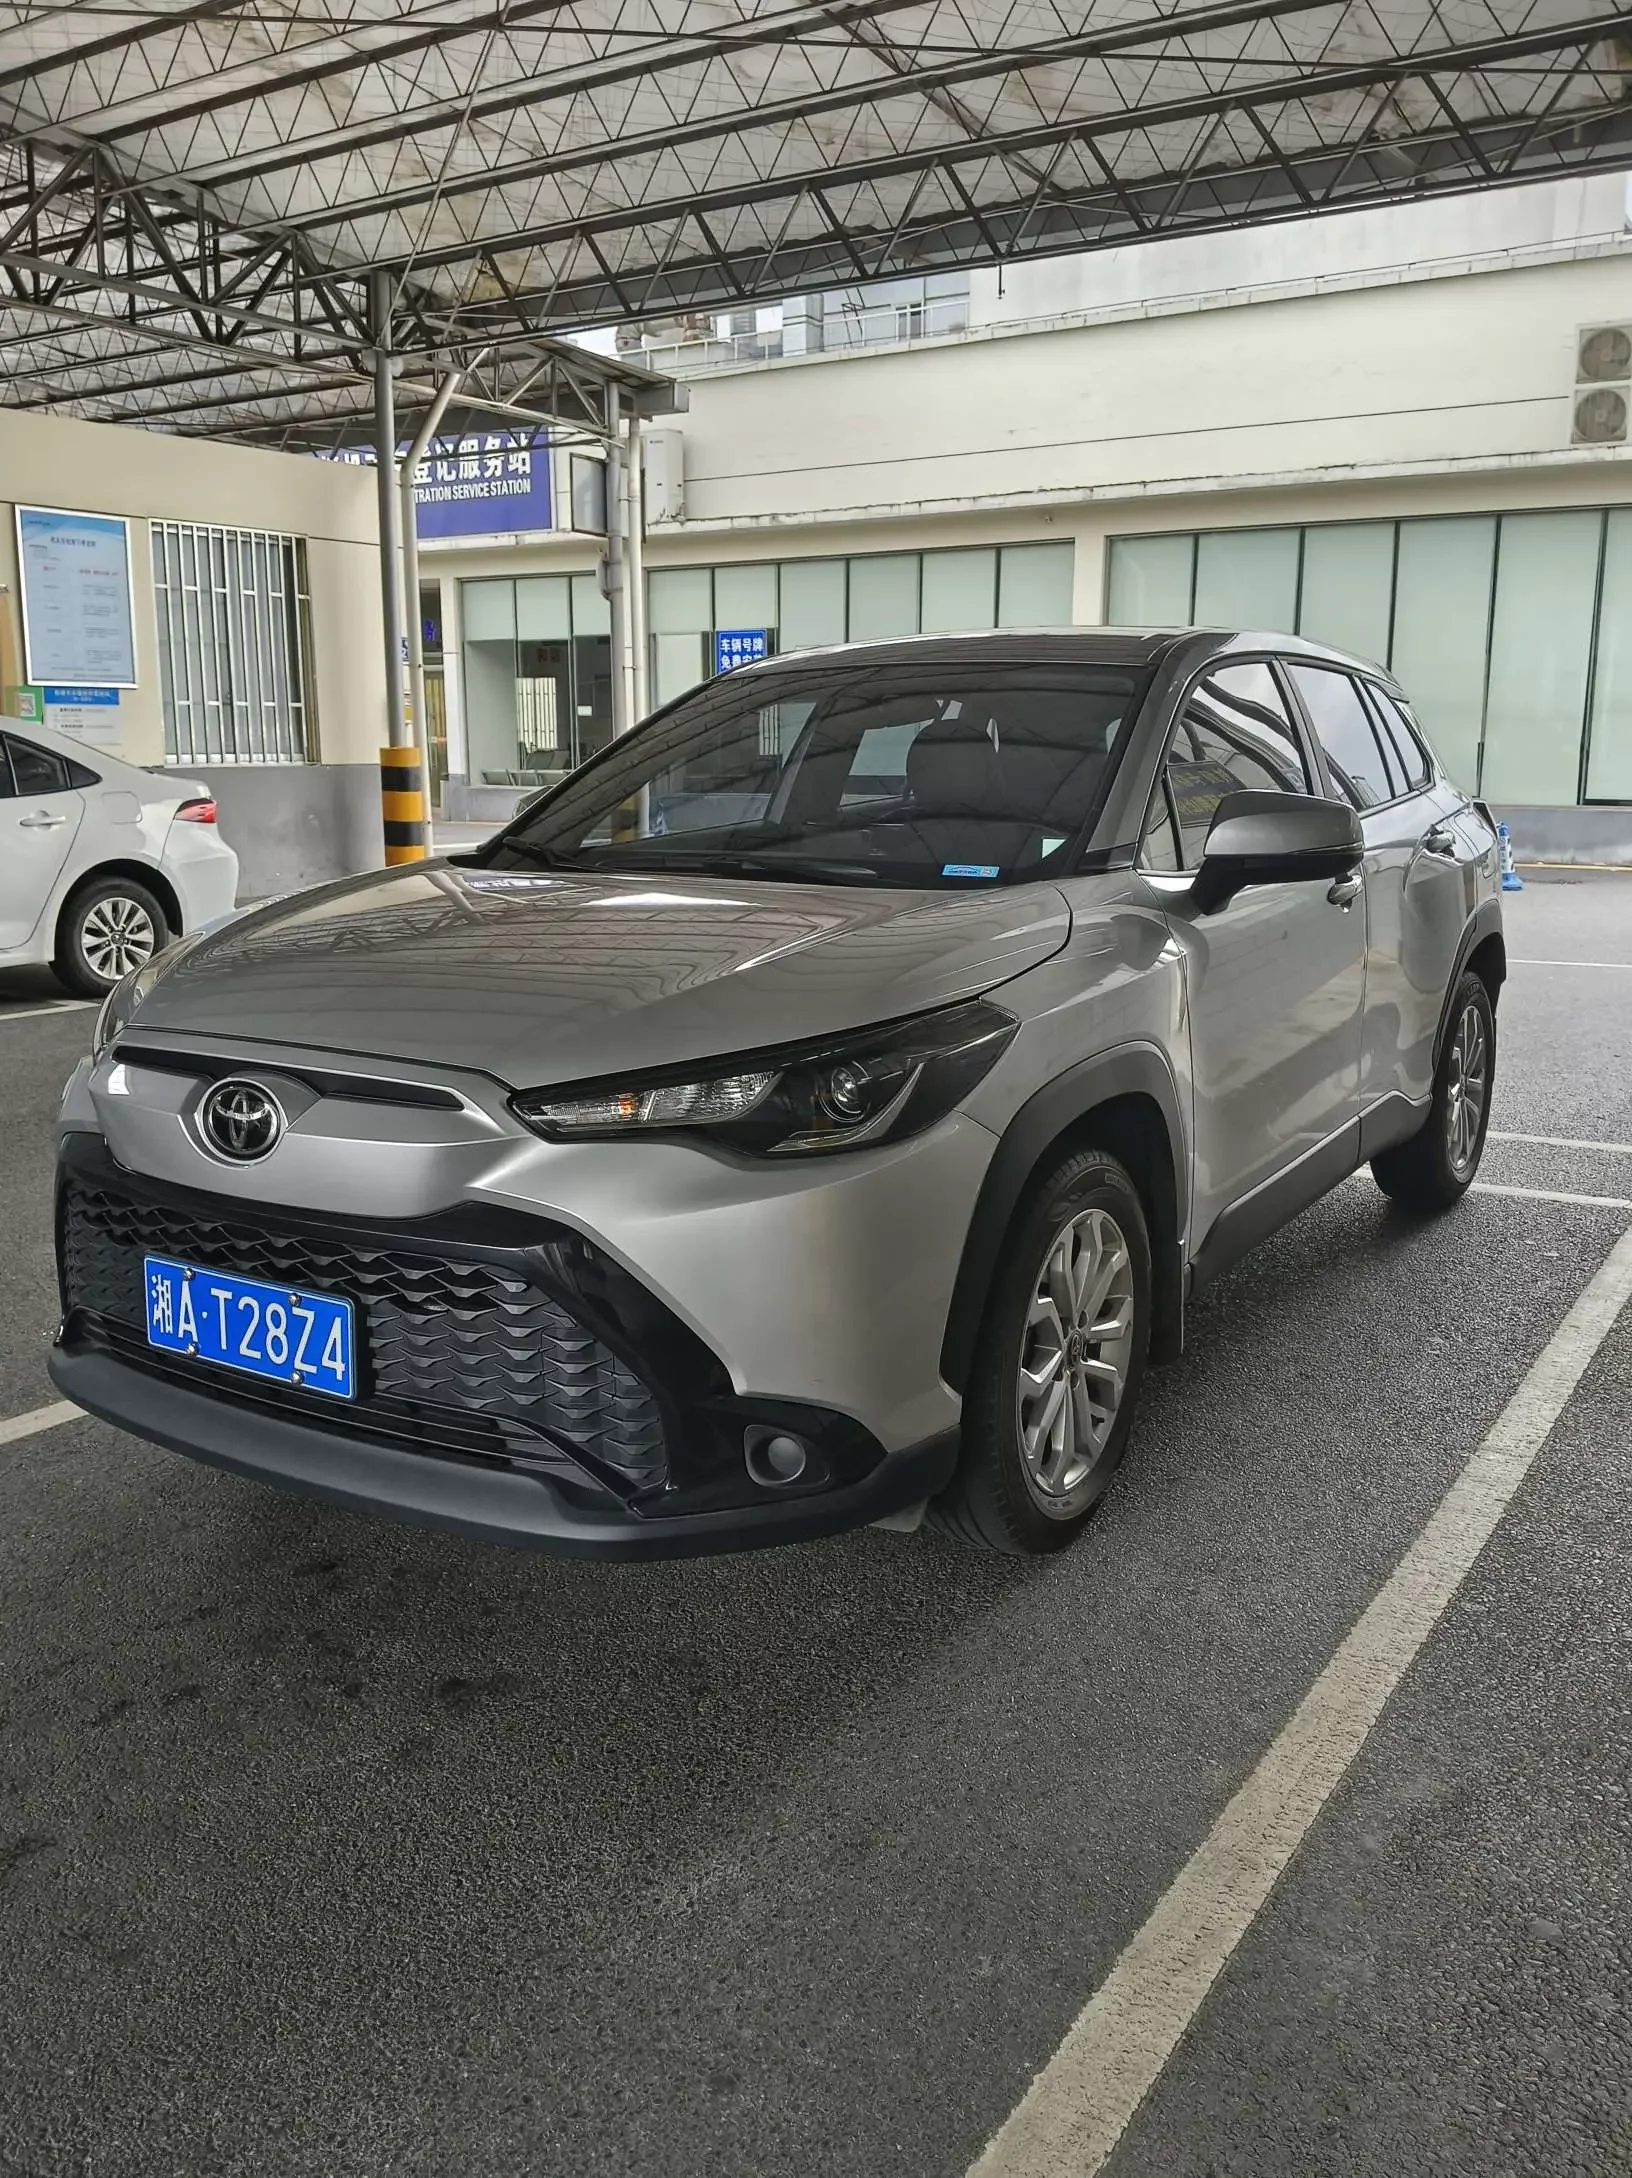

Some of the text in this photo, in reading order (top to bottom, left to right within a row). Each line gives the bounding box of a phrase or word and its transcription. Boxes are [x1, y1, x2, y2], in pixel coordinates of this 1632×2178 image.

[393, 432, 531, 485] 登记服务站
[414, 478, 531, 504] TRATION SERVICE STATION
[720, 638, 763, 653] 车辆号牌
